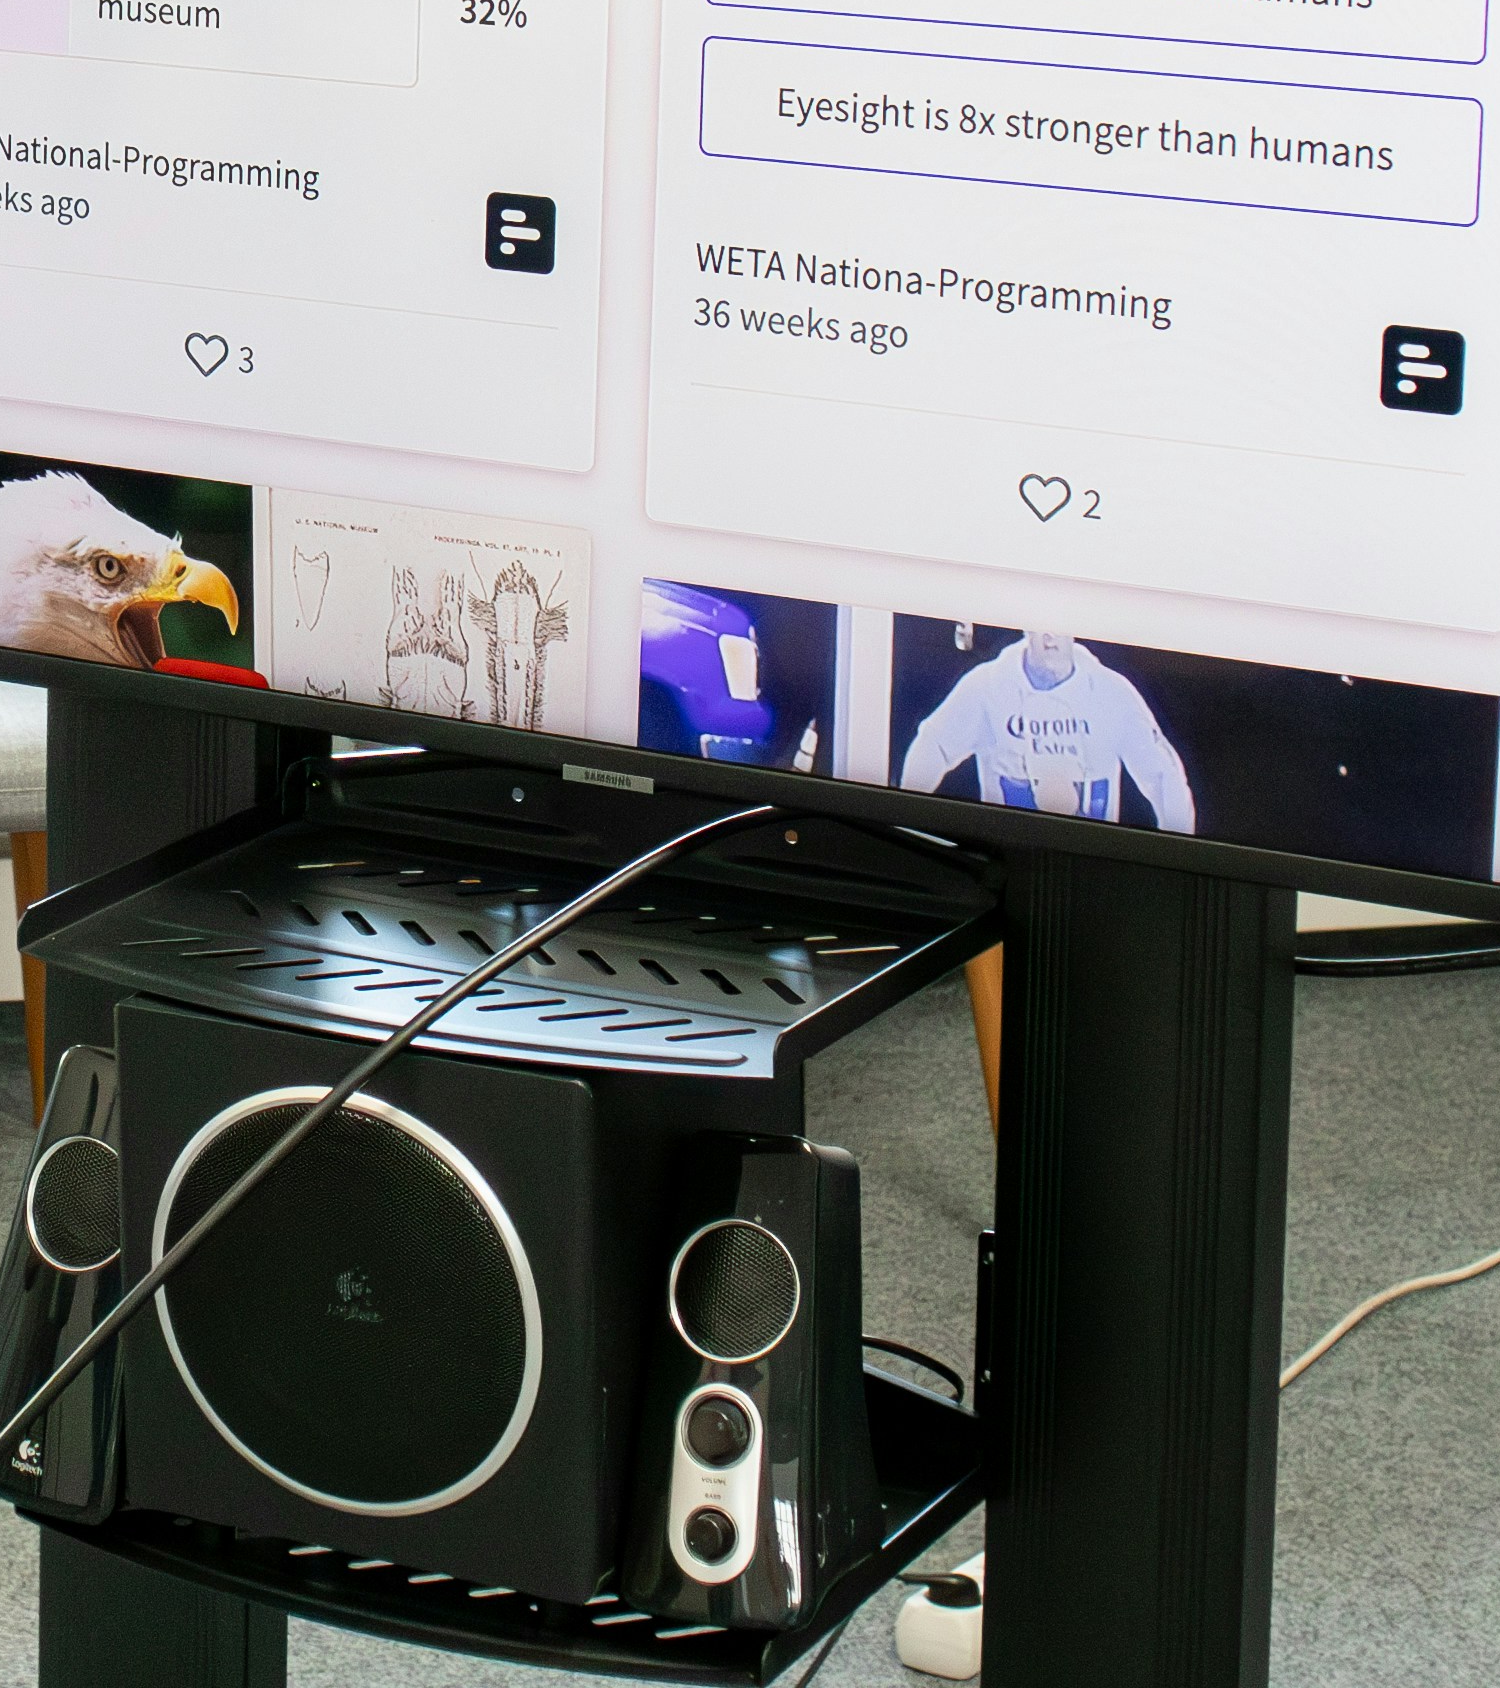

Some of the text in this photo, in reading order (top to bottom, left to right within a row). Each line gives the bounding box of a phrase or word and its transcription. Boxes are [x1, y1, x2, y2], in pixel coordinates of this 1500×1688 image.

[40, 194, 90, 226] ago
[696, 242, 1172, 331] WETA Nationa-Programming
[693, 297, 908, 355] 36 weeks ago
[238, 346, 254, 374] 3
[1082, 489, 1102, 520] 2
[583, 769, 633, 788] SAMSUNG
